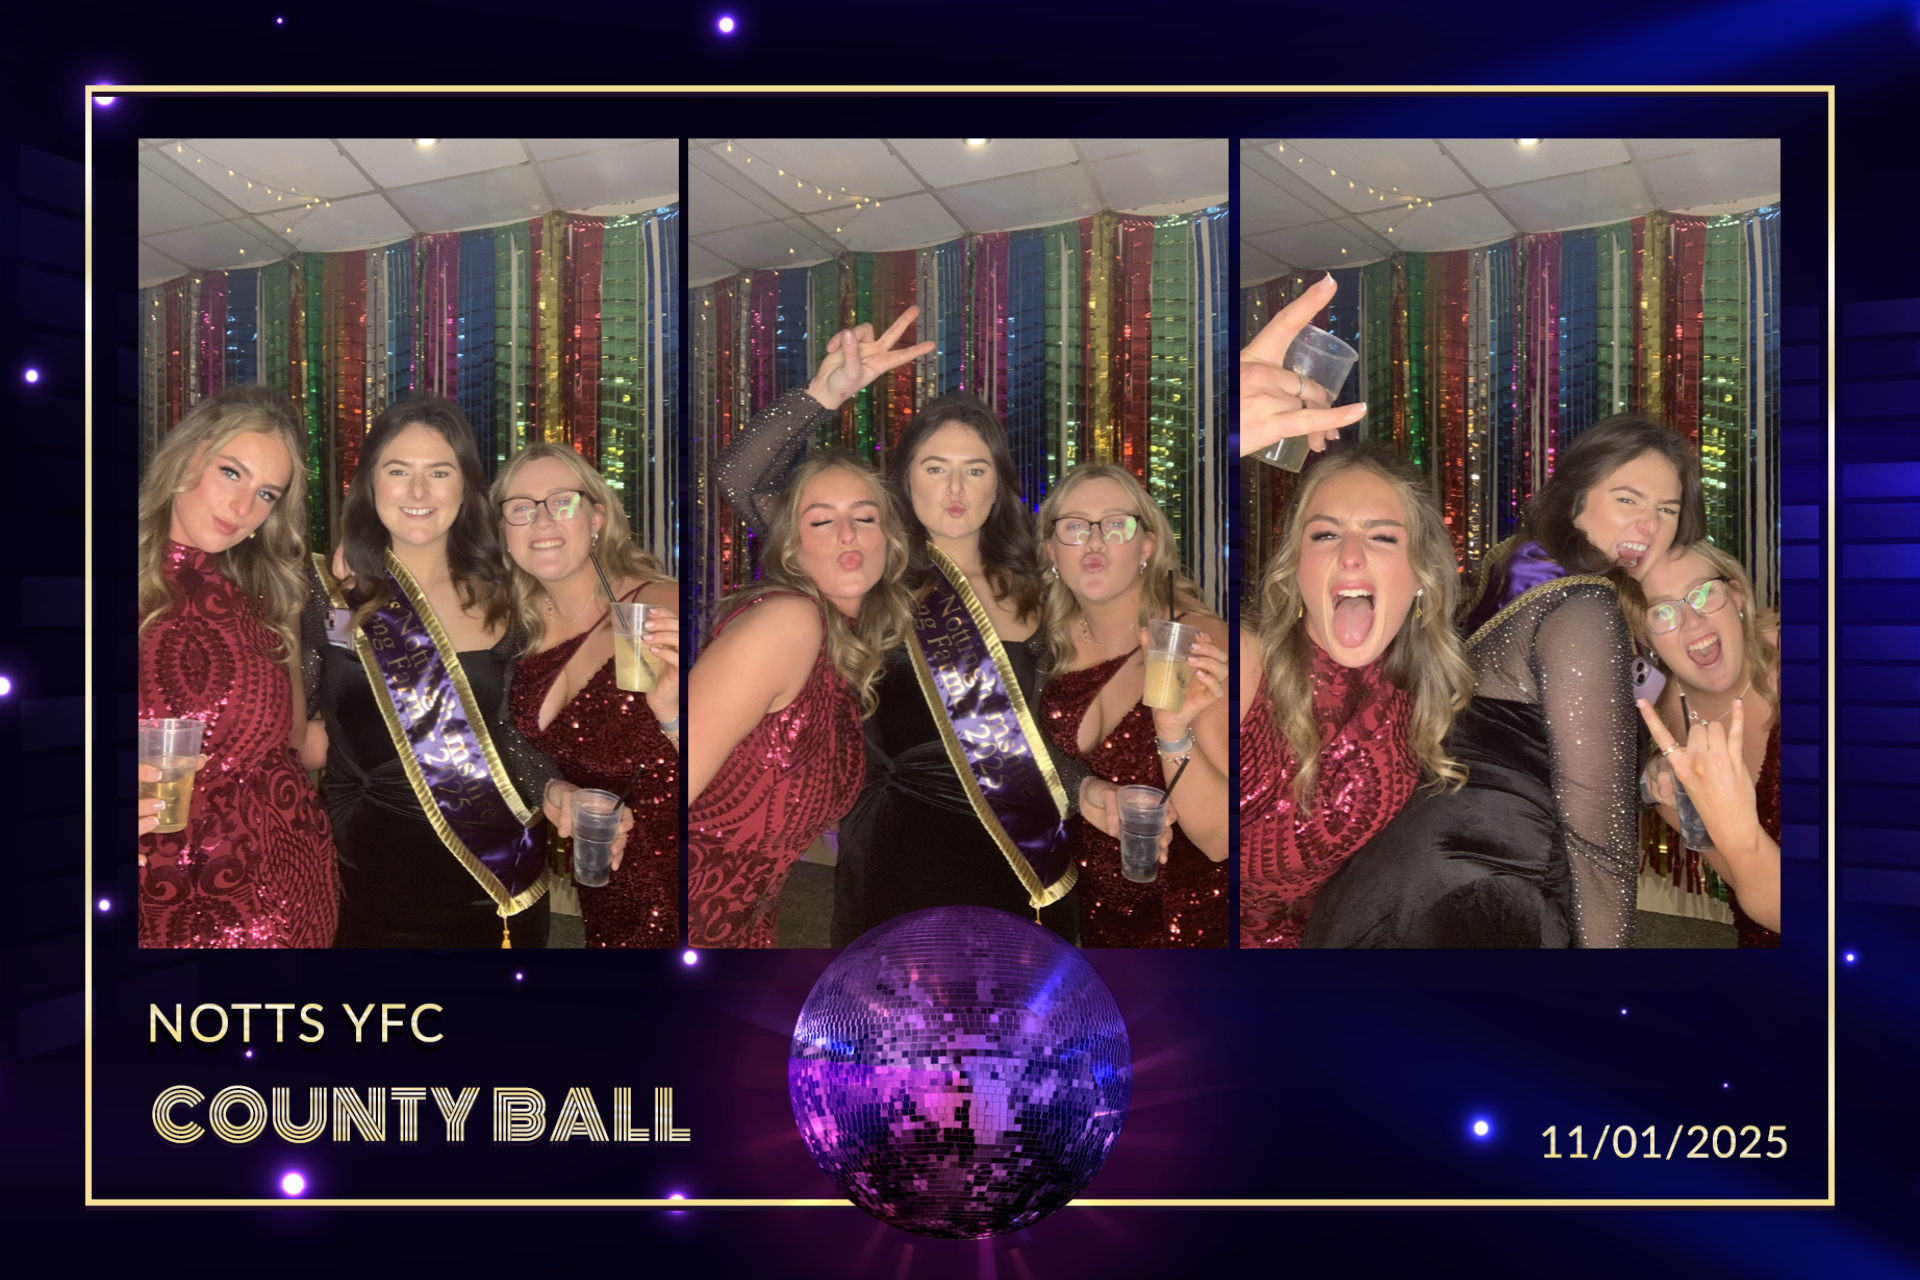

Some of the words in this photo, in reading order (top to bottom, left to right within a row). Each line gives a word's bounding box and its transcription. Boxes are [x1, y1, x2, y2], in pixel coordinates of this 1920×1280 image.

[387, 654, 435, 742] Farmer
[424, 748, 472, 811] 2025
[393, 610, 498, 819] Nottinghamshire
[927, 634, 977, 719] Farmer
[964, 724, 1011, 789] 2025
